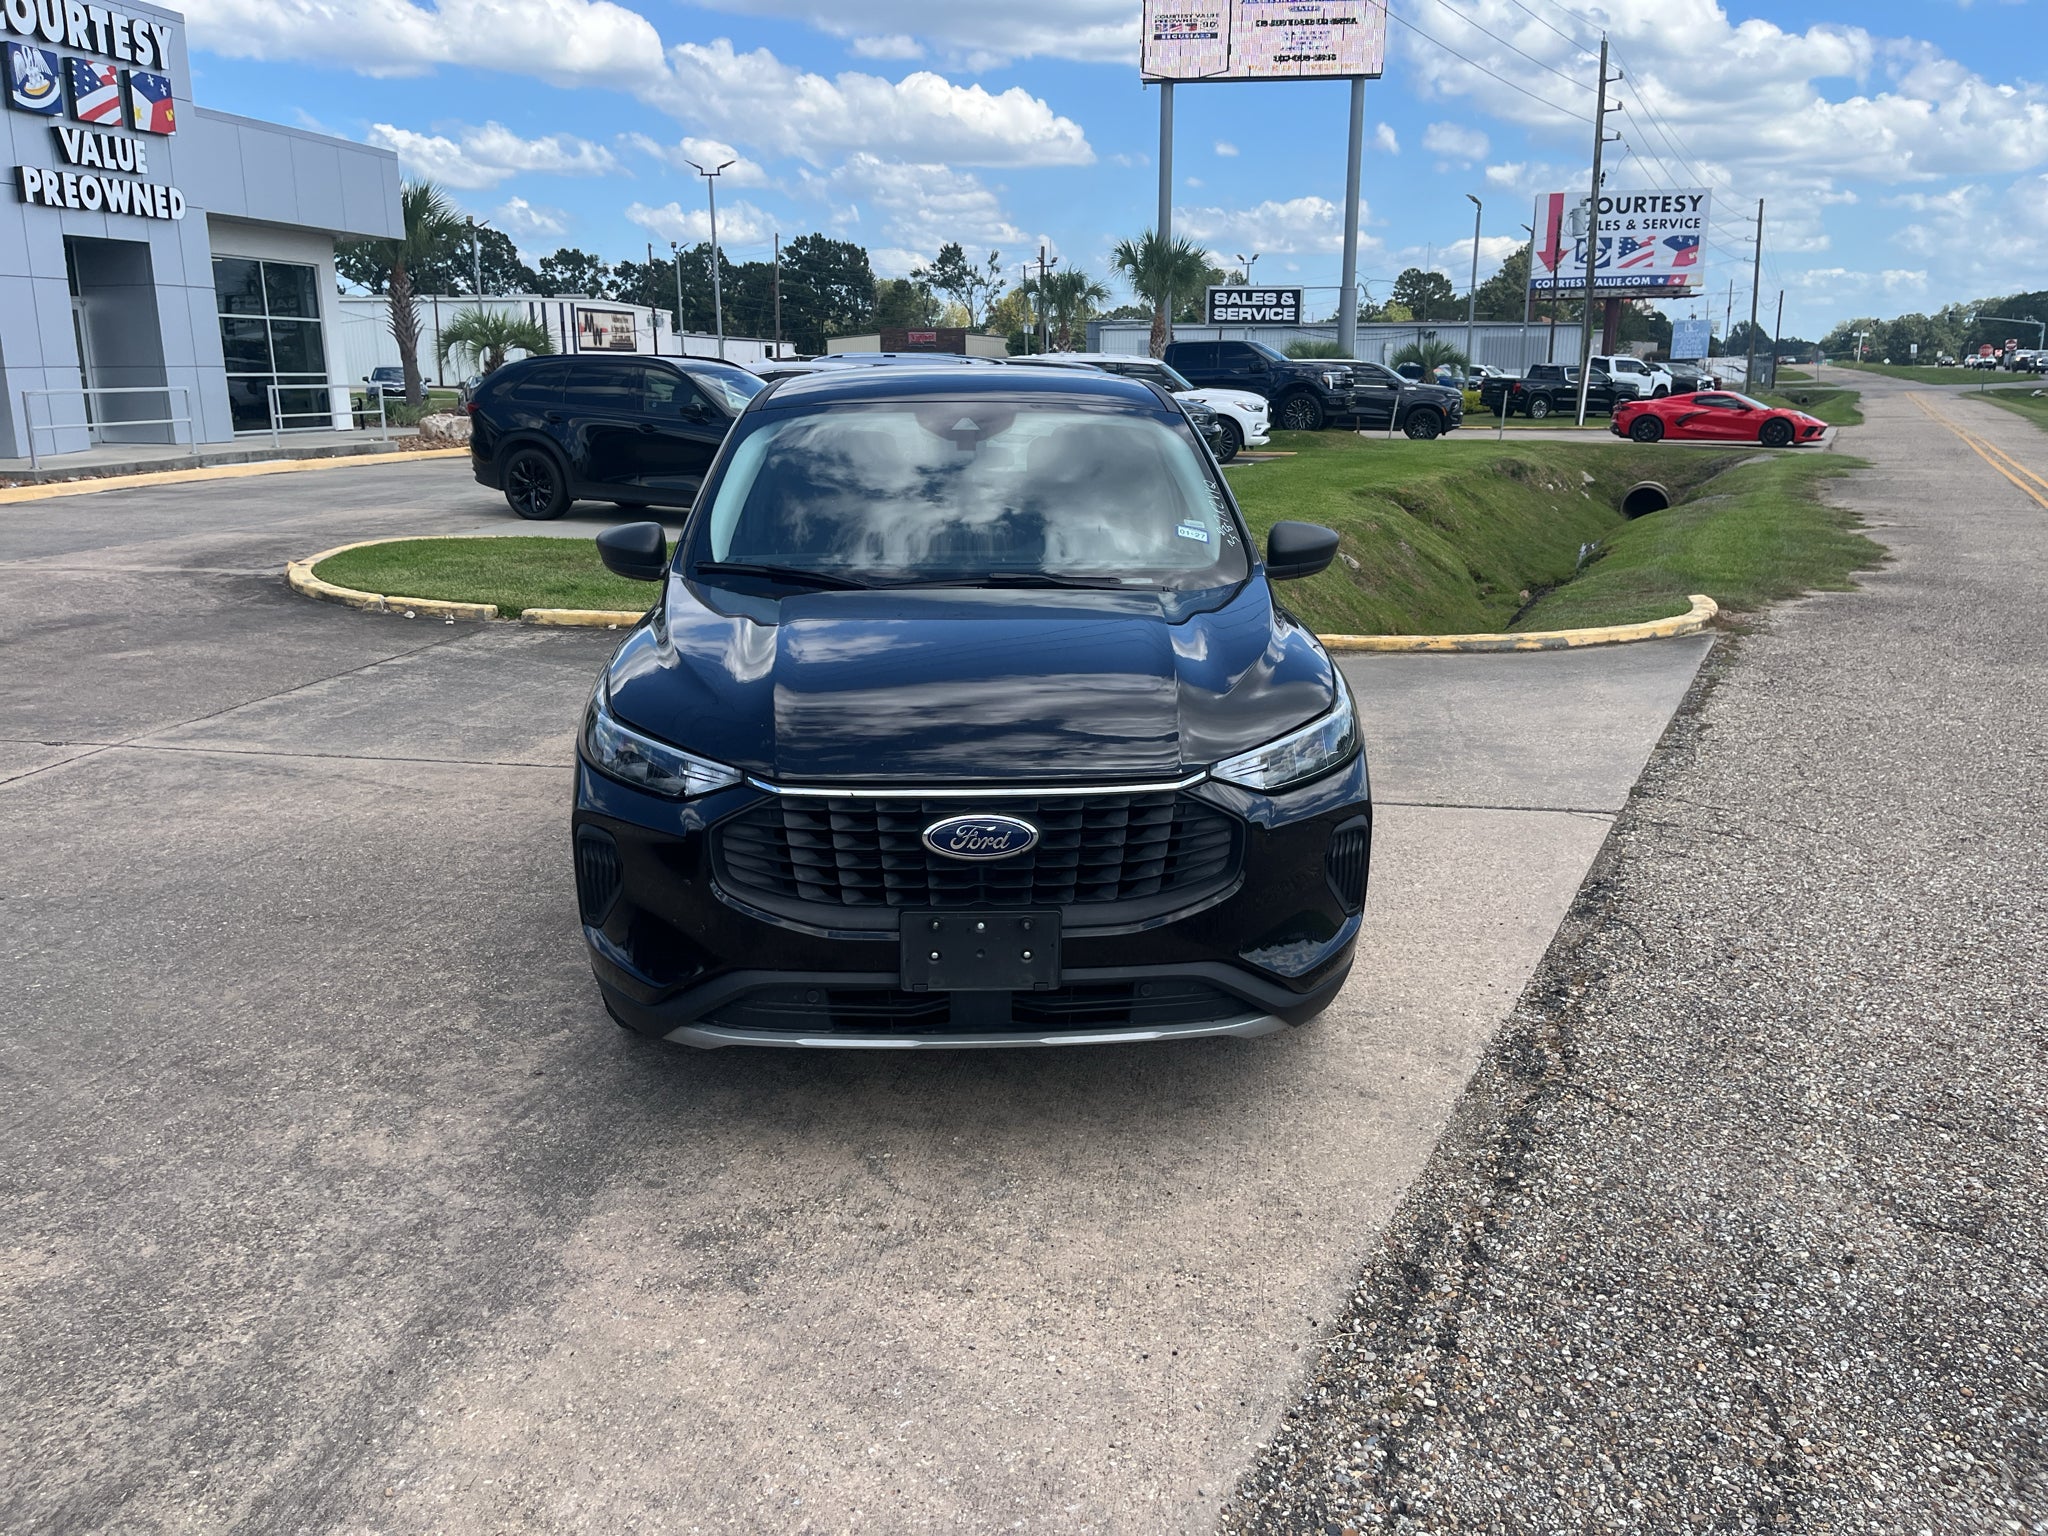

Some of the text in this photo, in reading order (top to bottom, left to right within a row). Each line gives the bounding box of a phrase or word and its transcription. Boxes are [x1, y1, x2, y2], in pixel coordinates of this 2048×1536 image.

[0, 0, 172, 70] OURTESY
[56, 126, 149, 174] VALUE
[19, 165, 186, 221] PREOWNED
[1585, 194, 1704, 215] OURTESY
[1585, 217, 1701, 232] LES & SERVICE
[1214, 292, 1295, 306] SALES &
[1213, 307, 1296, 321] SERVICE
[949, 824, 1012, 851] Ford
